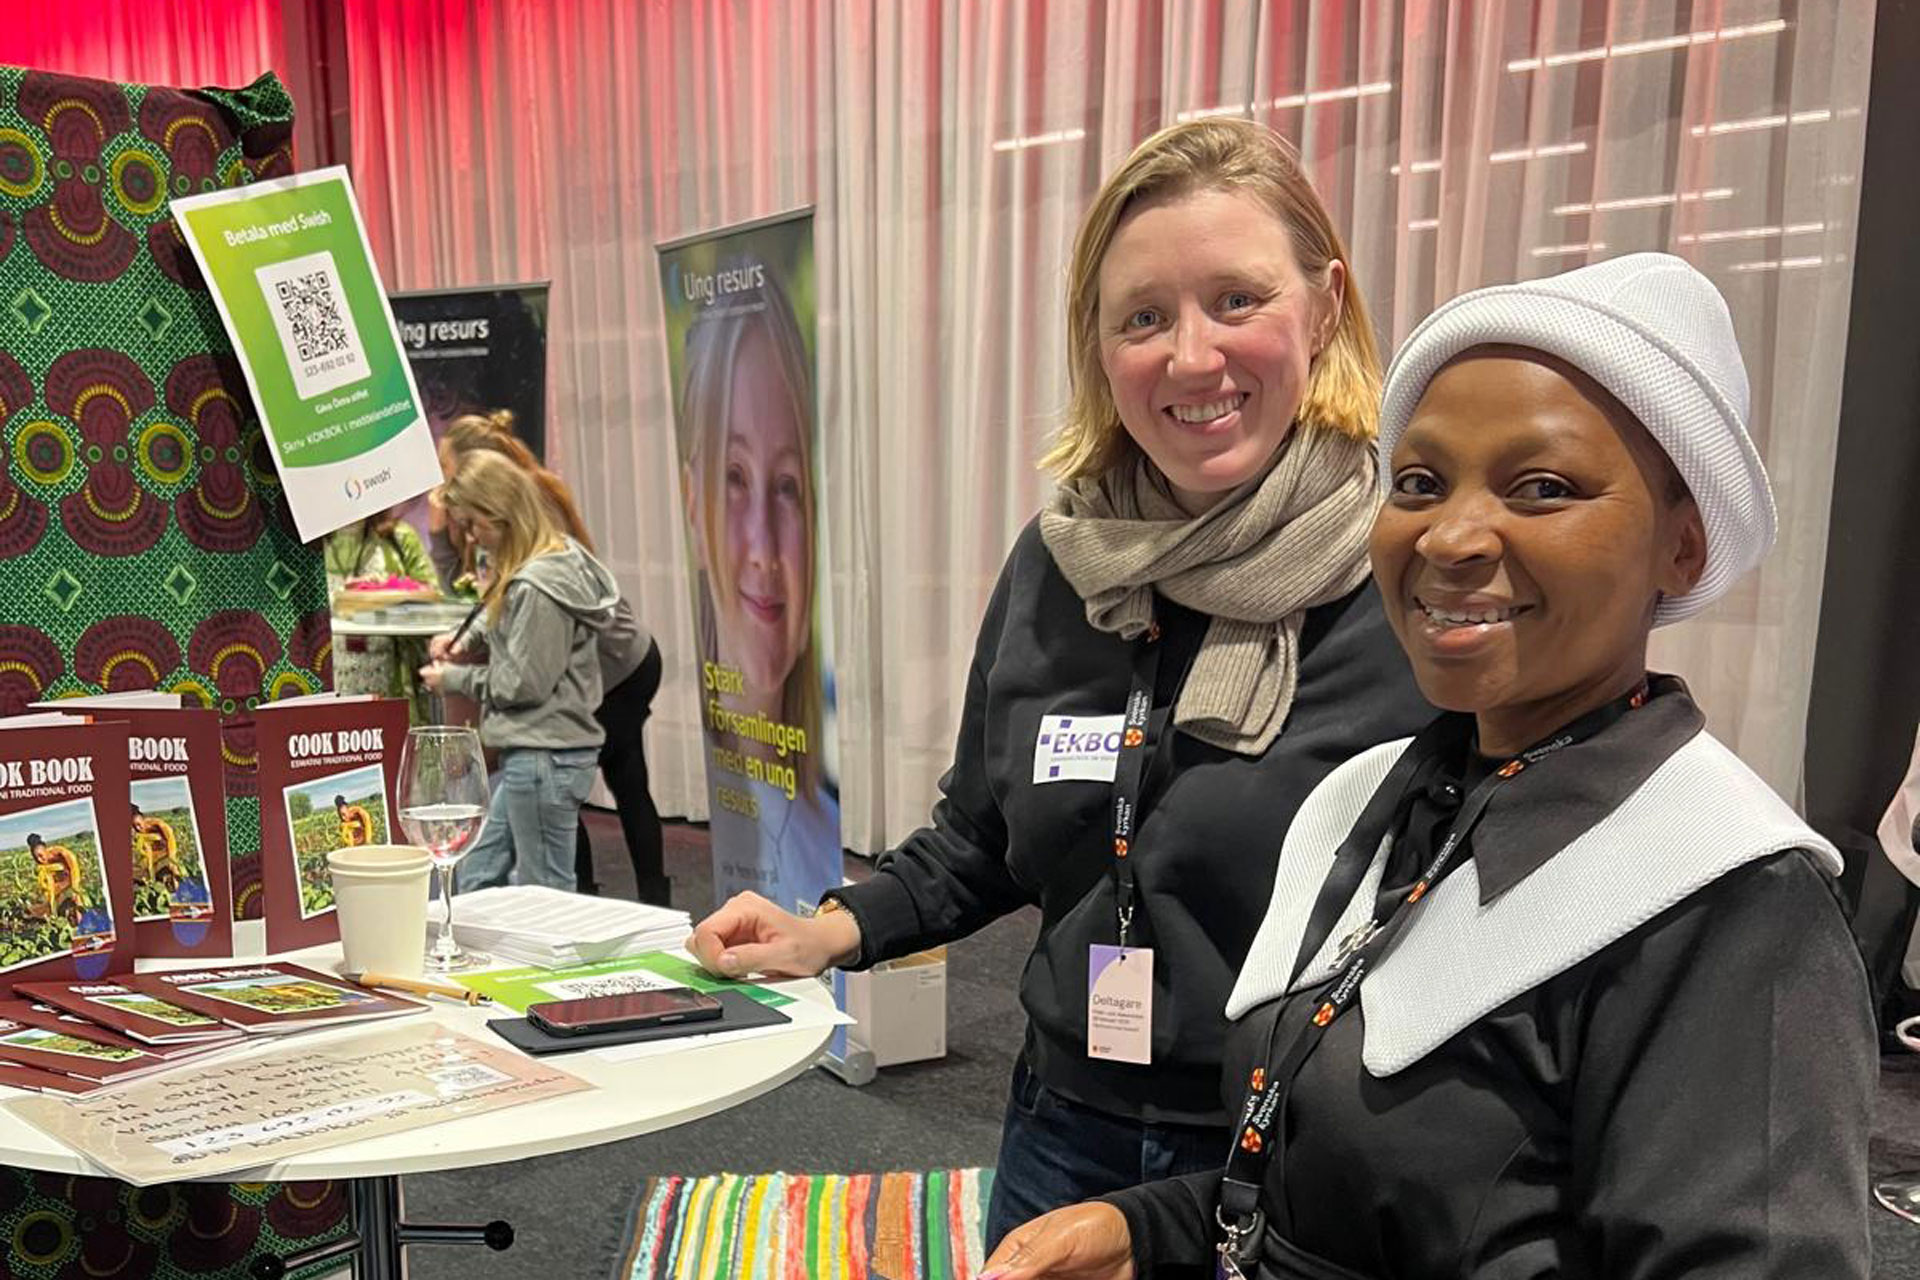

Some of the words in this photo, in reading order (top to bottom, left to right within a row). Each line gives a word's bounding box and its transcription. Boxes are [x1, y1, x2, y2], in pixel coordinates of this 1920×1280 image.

[223, 225, 269, 247] Betala
[268, 215, 300, 237] med
[298, 209, 333, 230] Swish
[684, 273, 715, 306] Ung
[716, 264, 765, 294] resurs
[429, 319, 490, 342] resurs
[128, 737, 189, 762] BOOK
[288, 732, 334, 758] COOK
[337, 728, 384, 754] BOOK
[364, 751, 383, 761] FOOD
[1053, 732, 1122, 753] EKBO
[30, 756, 95, 786] BOOK
[163, 763, 188, 772] FOOD
[745, 756, 763, 781] en
[766, 762, 796, 801] ung
[10, 785, 66, 799] TRADITIONAL
[68, 784, 92, 795] FOOD
[1330, 958, 1365, 1001] Svenska
[1252, 1081, 1280, 1125] Svenska
